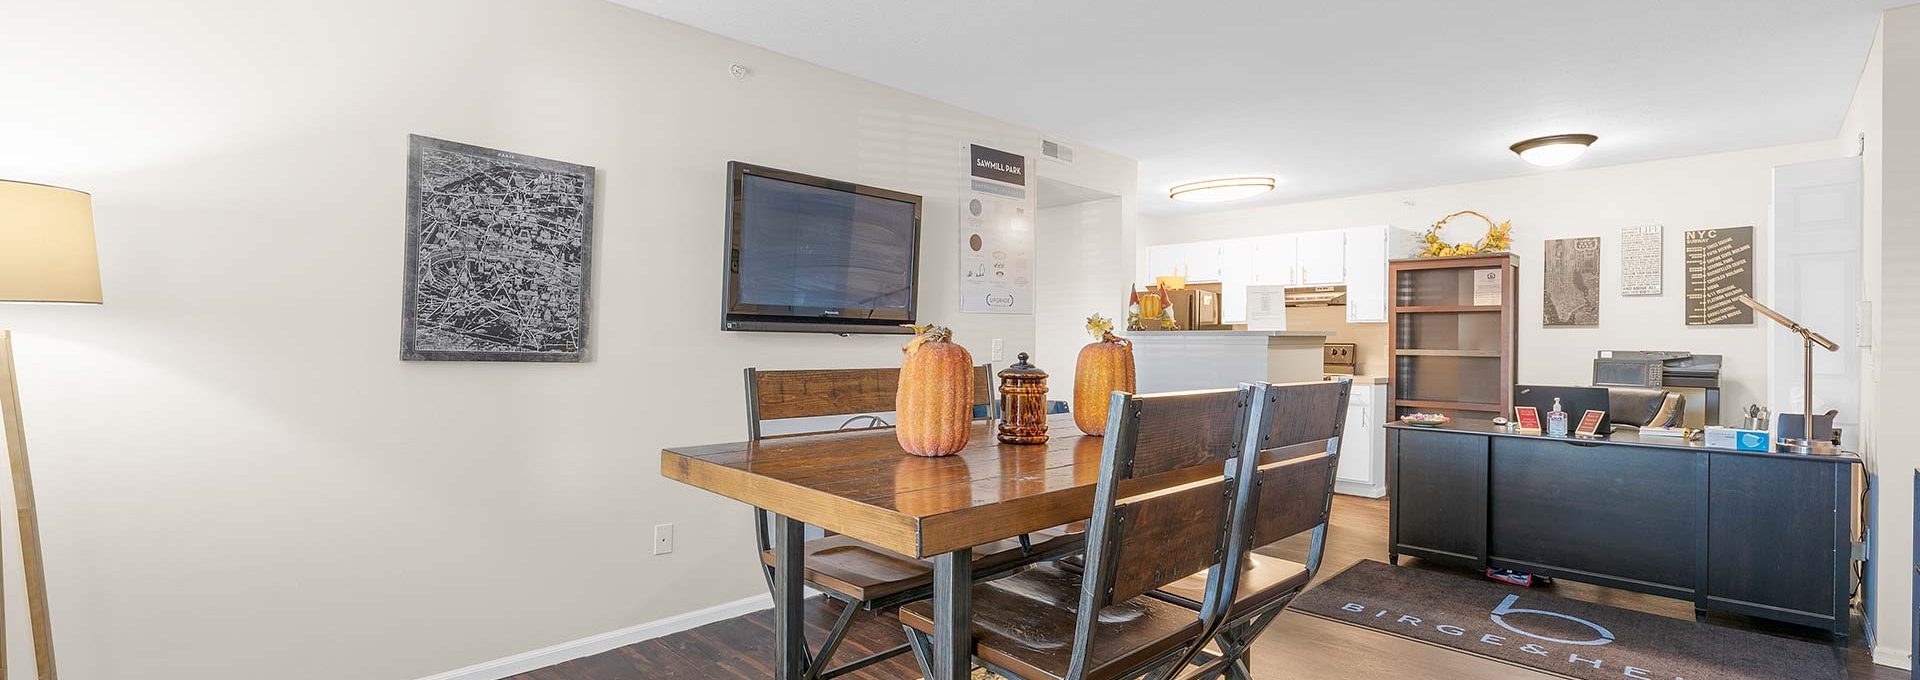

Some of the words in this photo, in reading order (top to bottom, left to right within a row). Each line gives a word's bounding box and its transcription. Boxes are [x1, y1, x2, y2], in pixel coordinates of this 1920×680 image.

[976, 158, 1005, 172] SAWMILL
[1005, 164, 1022, 176] PARK
[1686, 230, 1717, 240] NYC
